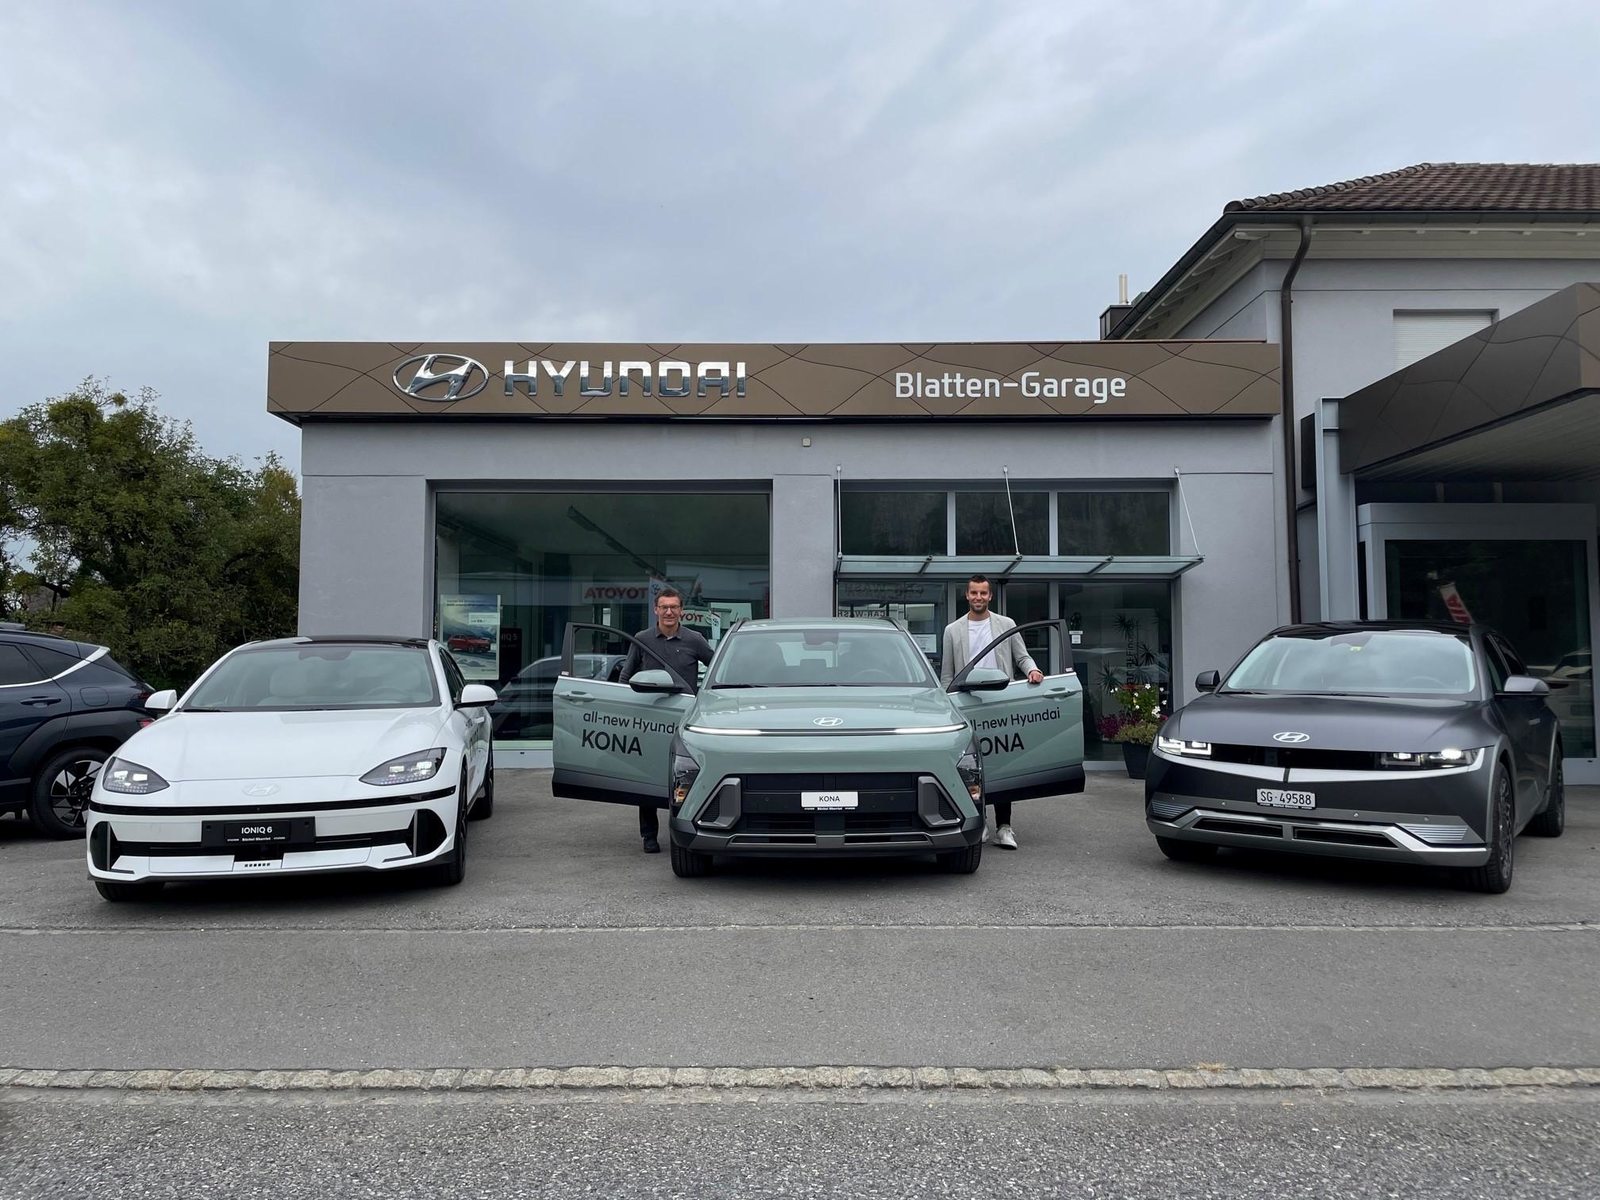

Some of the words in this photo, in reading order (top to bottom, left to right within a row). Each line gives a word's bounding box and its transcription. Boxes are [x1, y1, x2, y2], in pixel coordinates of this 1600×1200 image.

[504, 360, 746, 397] HYUNDAI
[895, 372, 1126, 404] Blatten-Garage
[583, 711, 630, 728] all-new
[632, 717, 679, 734] Hyund
[970, 717, 1008, 731] ll-new
[1010, 706, 1060, 727] Hyundai
[581, 729, 643, 757] KONA
[979, 732, 1025, 757] ONA
[818, 795, 841, 803] KONA
[241, 826, 267, 835] IONIQ
[267, 826, 273, 834] 6
